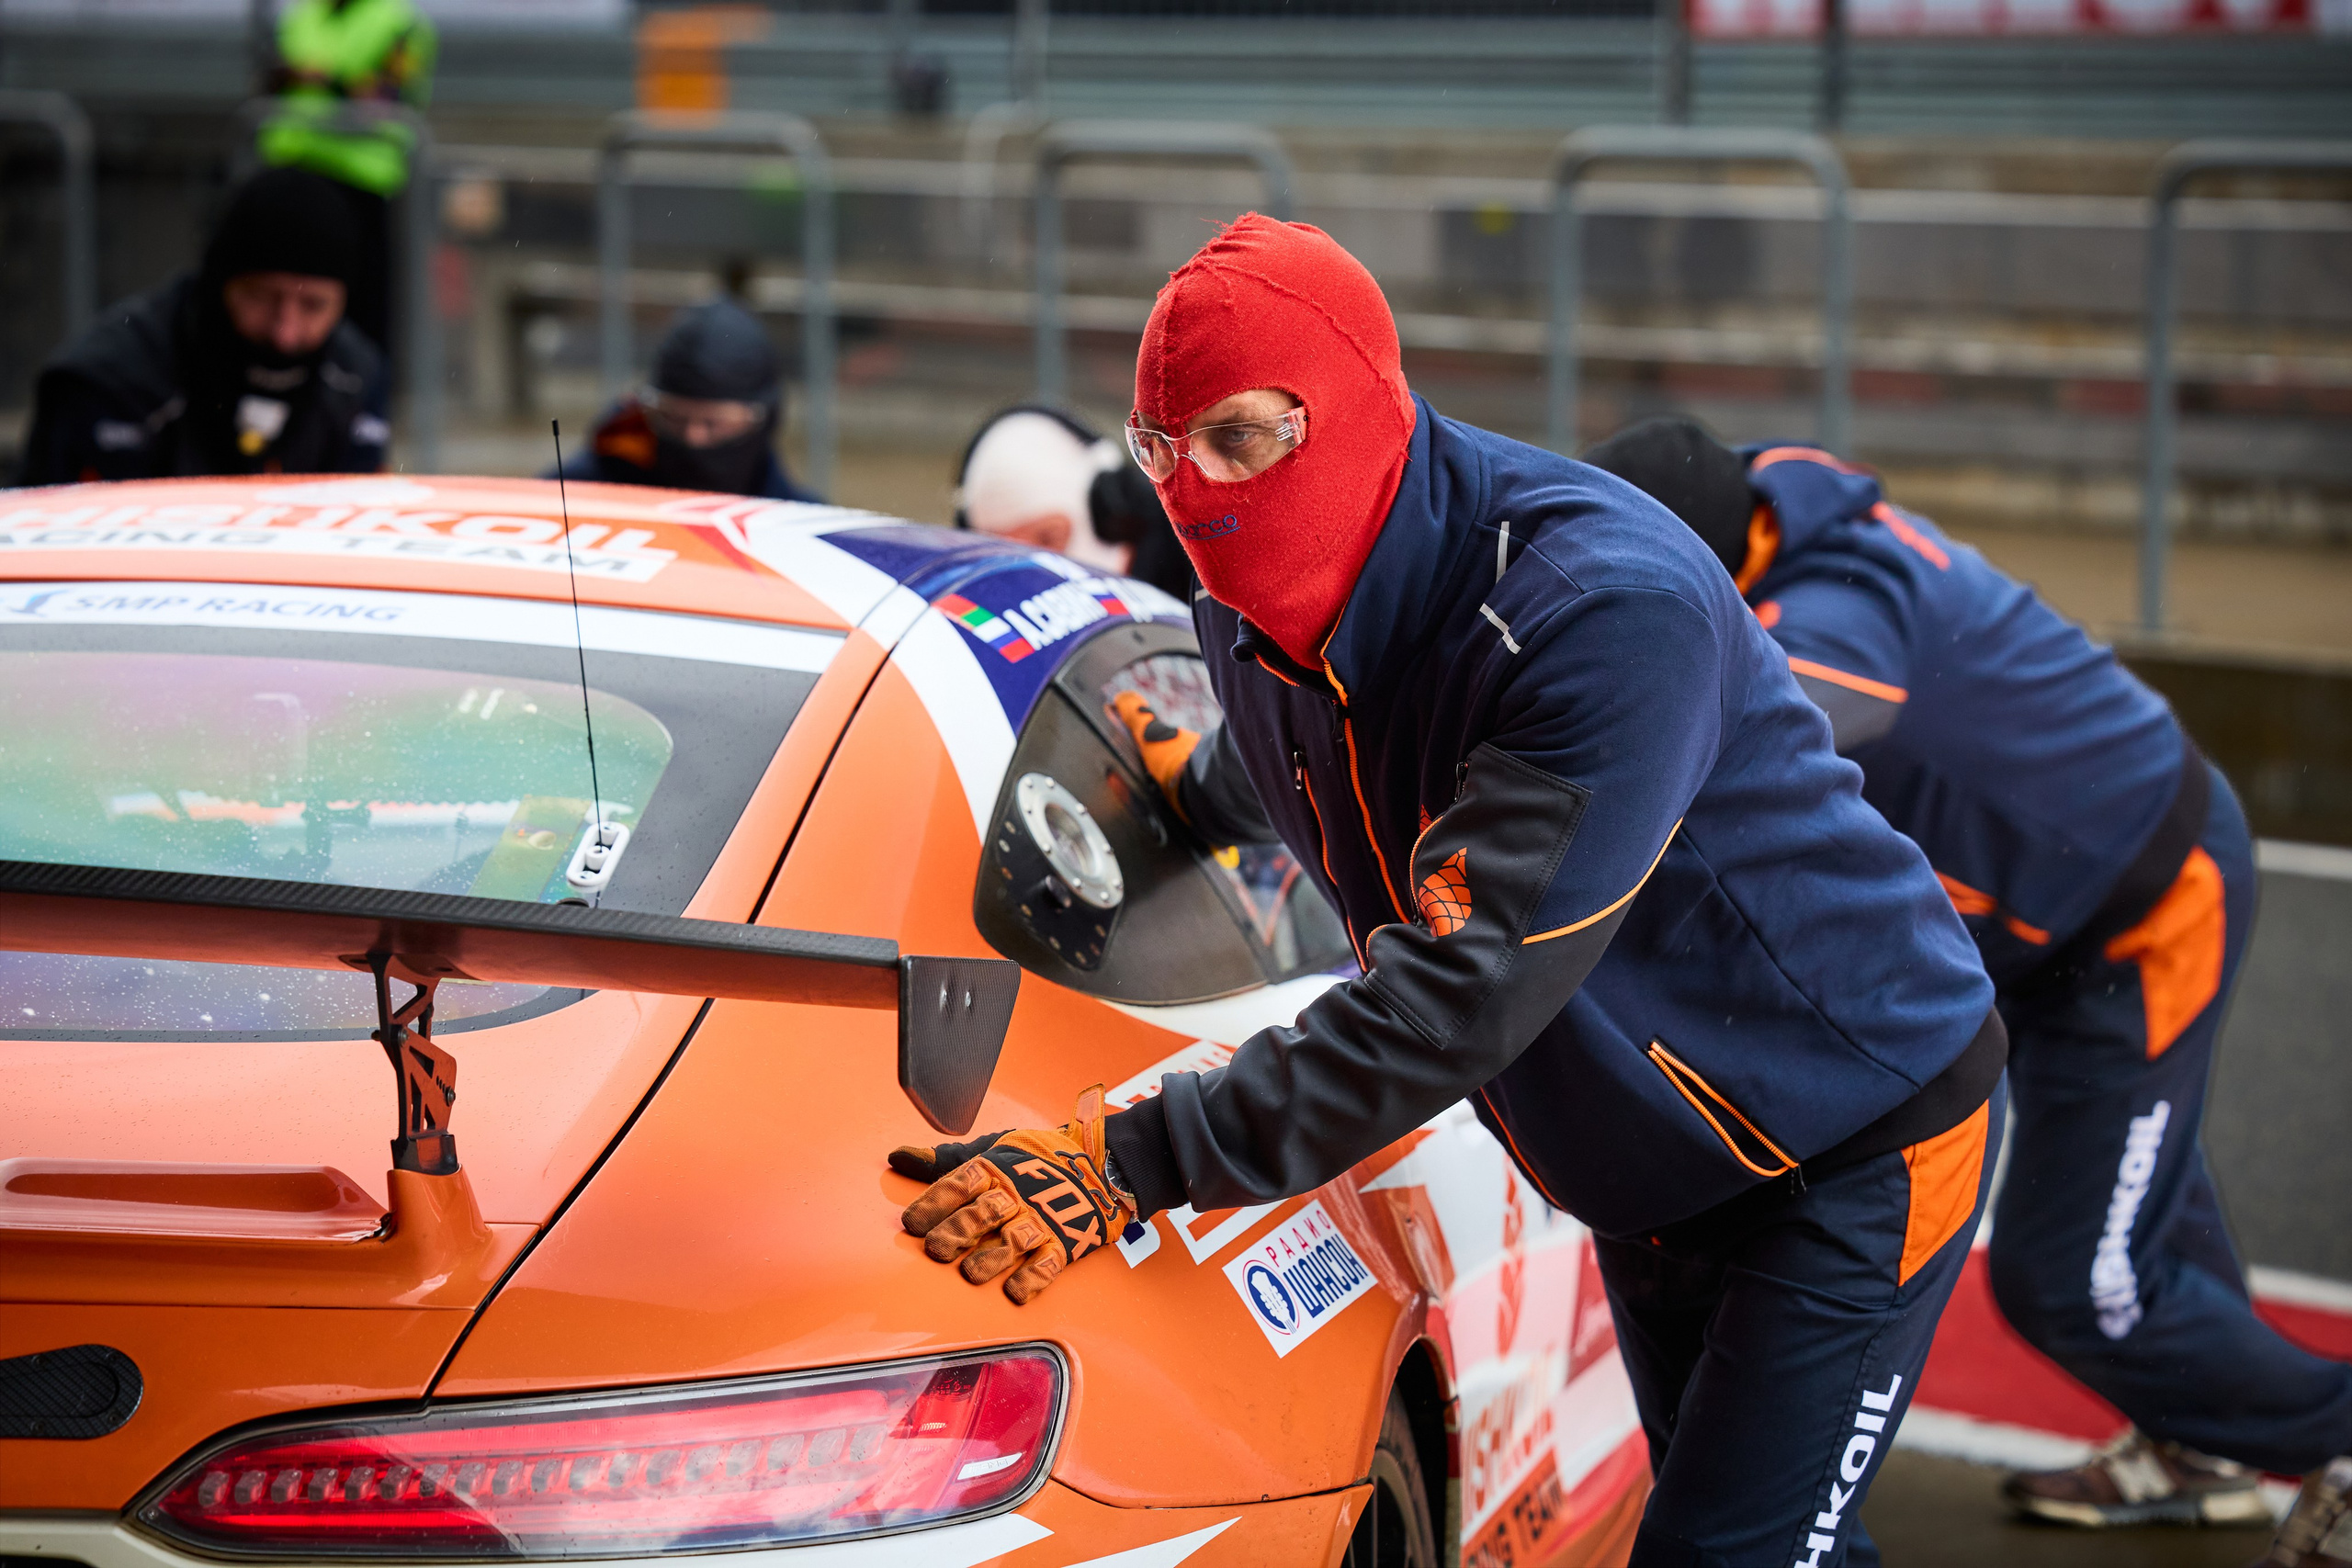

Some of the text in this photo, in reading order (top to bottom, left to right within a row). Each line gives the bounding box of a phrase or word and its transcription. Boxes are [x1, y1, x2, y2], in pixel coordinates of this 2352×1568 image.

[0, 529, 631, 572] CING TEAM
[65, 594, 407, 622] SMP RACING
[1012, 1157, 1102, 1262] FOX
[1265, 1209, 1331, 1269] РАДИО
[1283, 1233, 1369, 1319] ШАНСОН
